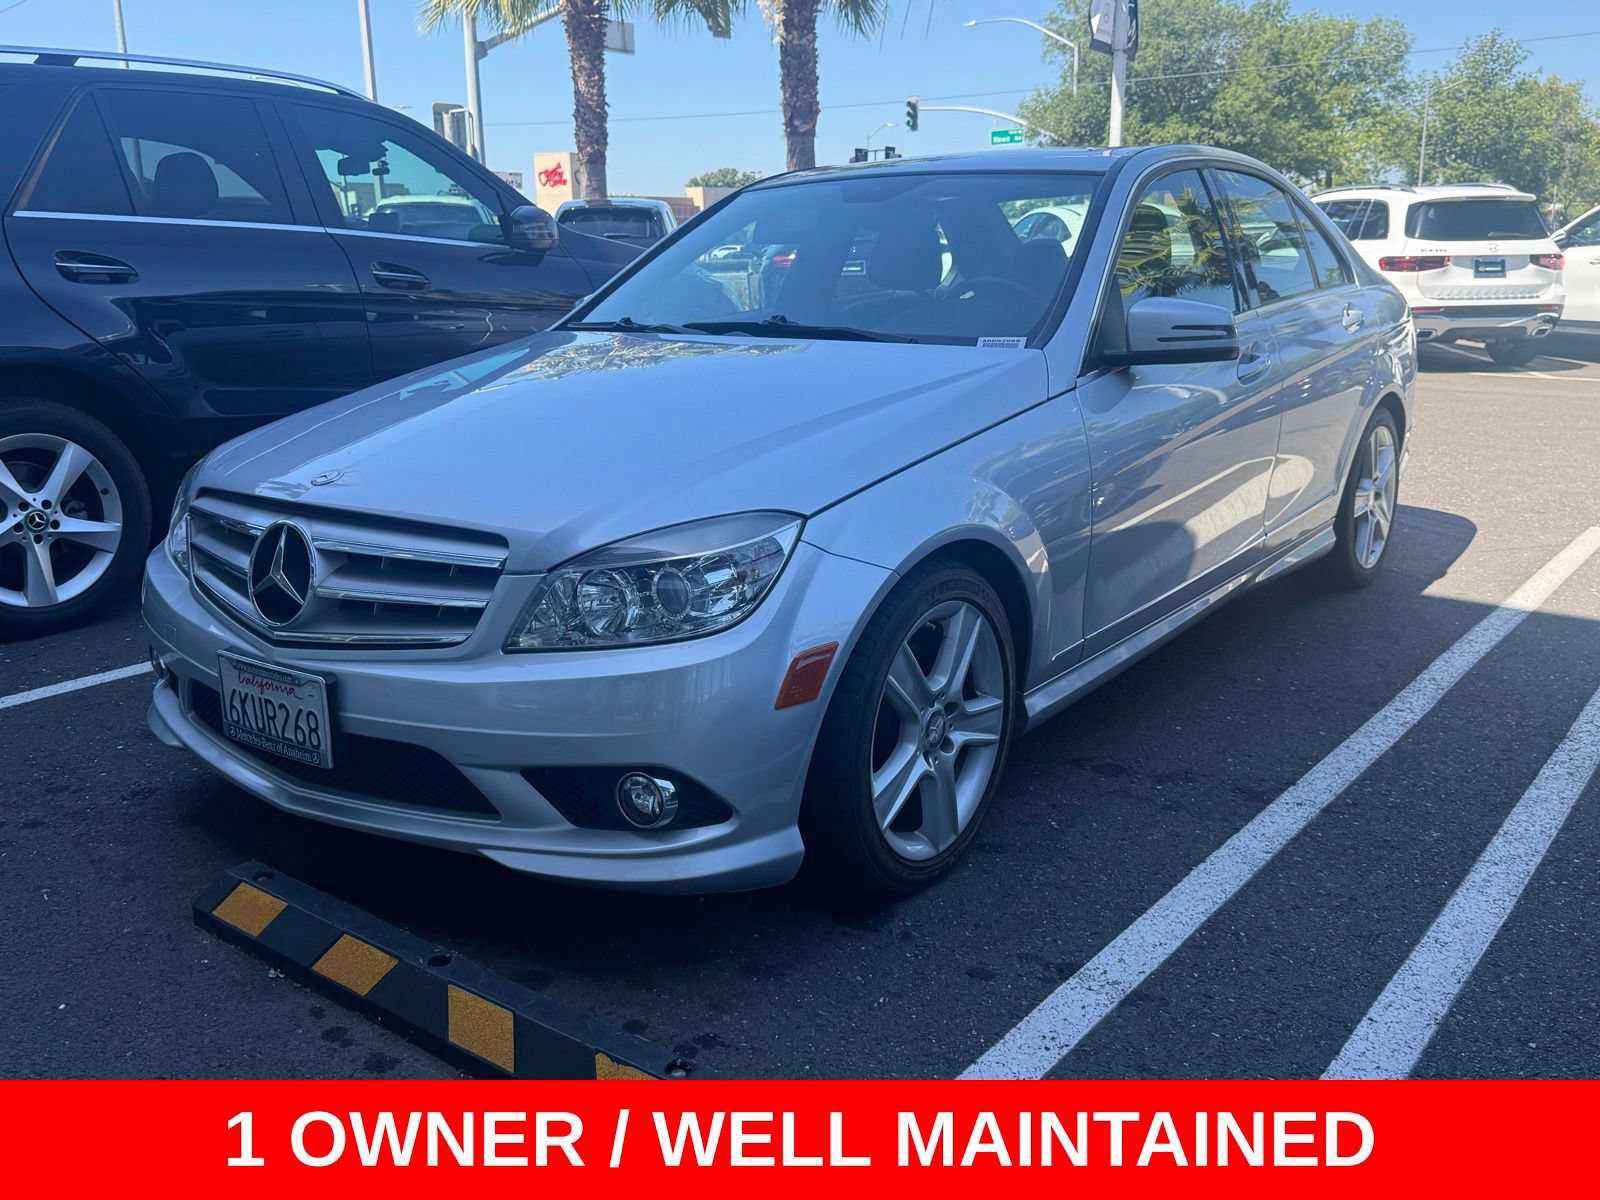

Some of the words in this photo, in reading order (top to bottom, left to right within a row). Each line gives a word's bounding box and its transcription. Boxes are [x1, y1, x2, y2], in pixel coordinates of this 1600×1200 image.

[237, 670, 303, 700] California
[229, 688, 321, 750] 6KUR268
[276, 743, 283, 754] of
[283, 745, 312, 763] Anaheim
